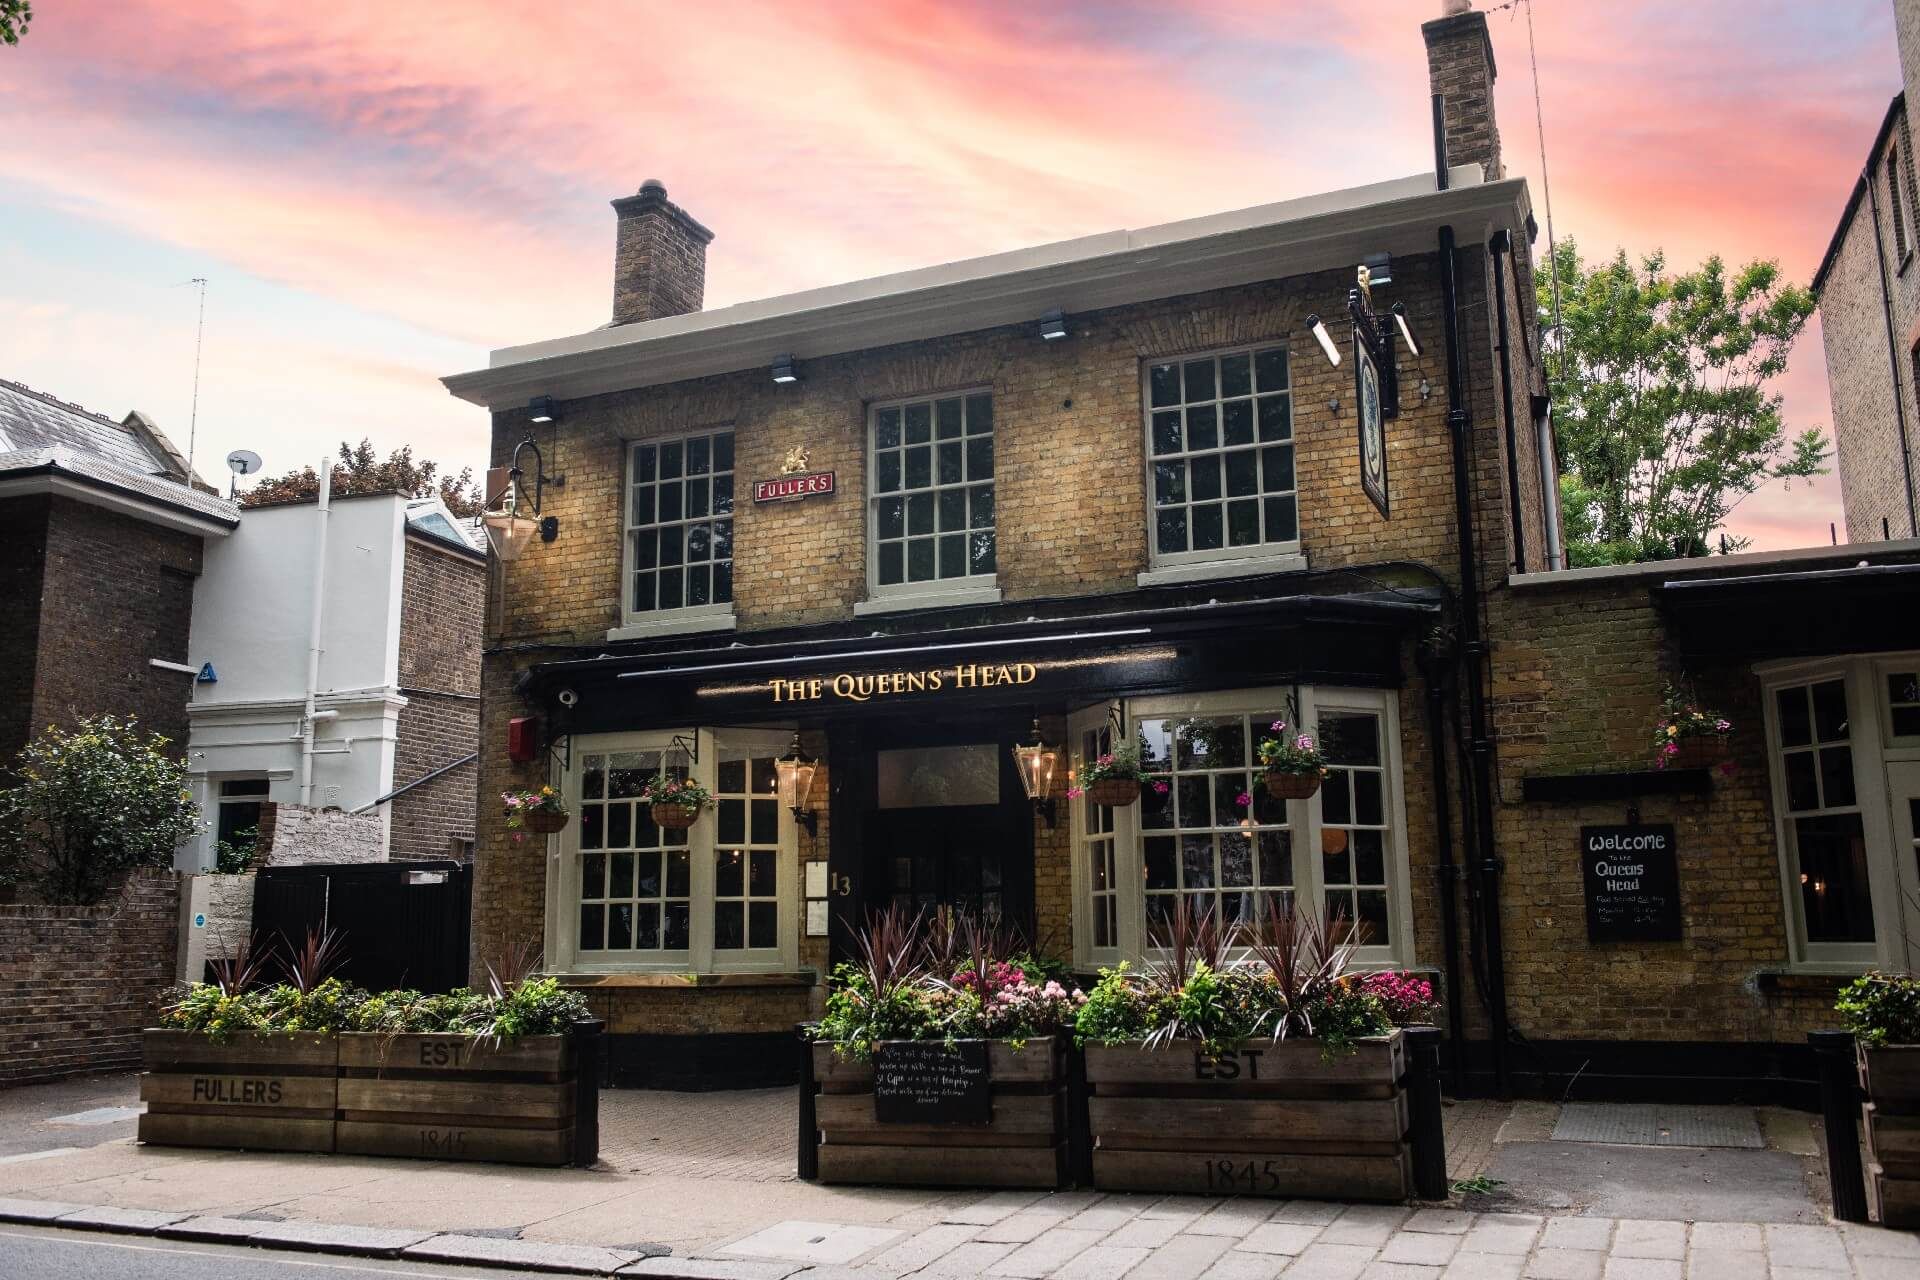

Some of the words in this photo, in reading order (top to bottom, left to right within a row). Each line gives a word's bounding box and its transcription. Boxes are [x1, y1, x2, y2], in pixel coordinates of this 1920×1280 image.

[758, 476, 827, 498] FULLER'S
[769, 679, 822, 702] THE
[833, 670, 942, 701] QUEENS
[956, 663, 1037, 688] HEAD
[1595, 861, 1644, 877] Queens
[832, 871, 851, 896] 13
[1606, 878, 1640, 892] Head
[419, 1040, 465, 1067] EST
[1195, 1049, 1264, 1080] EST
[193, 1078, 283, 1104] FULLERS
[419, 1129, 466, 1155] 1845
[1206, 1159, 1280, 1191] 1845
